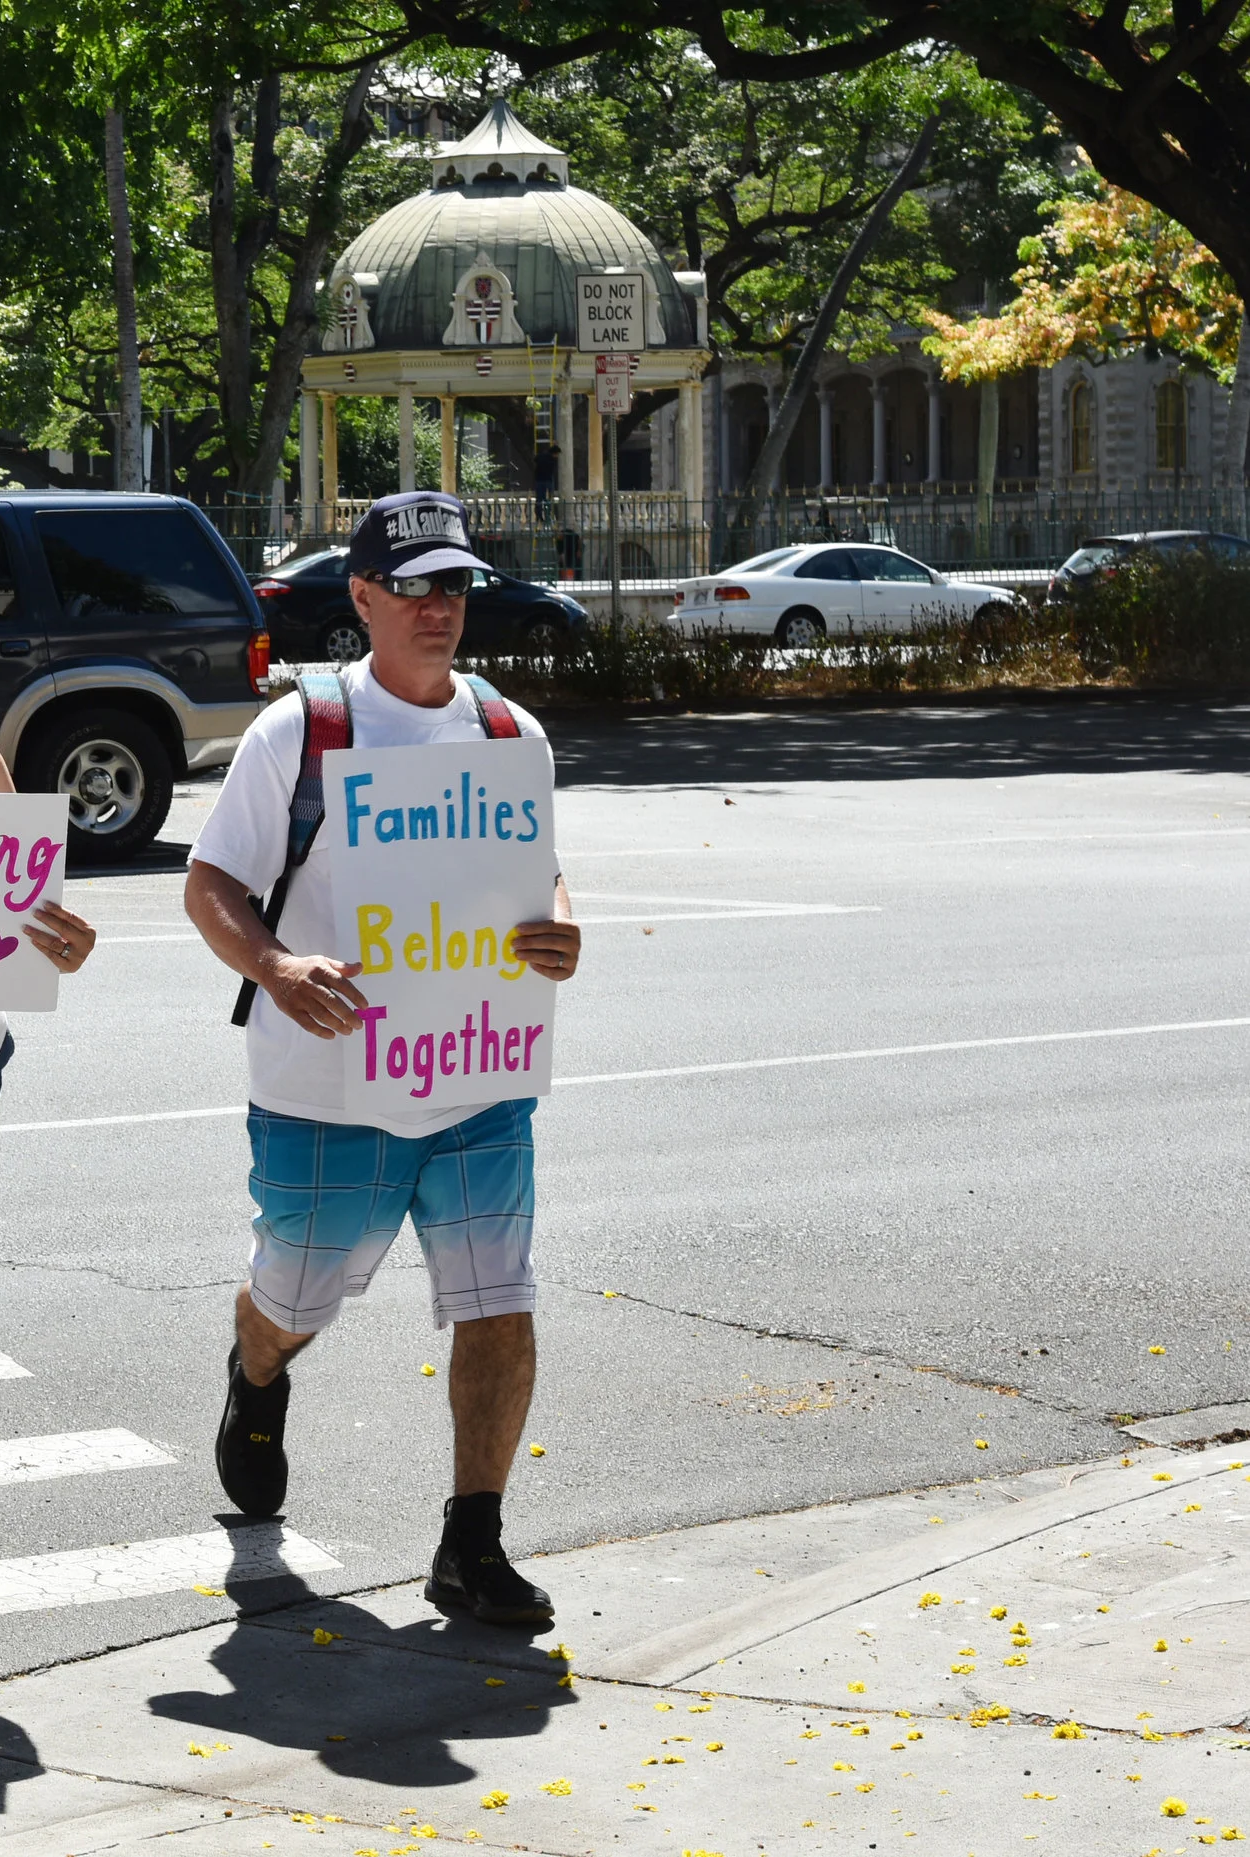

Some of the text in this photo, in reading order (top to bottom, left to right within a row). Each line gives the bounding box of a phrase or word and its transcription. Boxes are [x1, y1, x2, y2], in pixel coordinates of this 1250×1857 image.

[584, 284, 635, 299] DO NOT
[588, 305, 632, 321] BLOCK
[593, 328, 629, 342] LANE
[606, 377, 620, 386] OUT
[608, 389, 617, 397] OF
[603, 400, 623, 409] STALL
[344, 771, 539, 847] Families
[356, 901, 529, 981] Belong
[354, 1000, 544, 1099] Together
